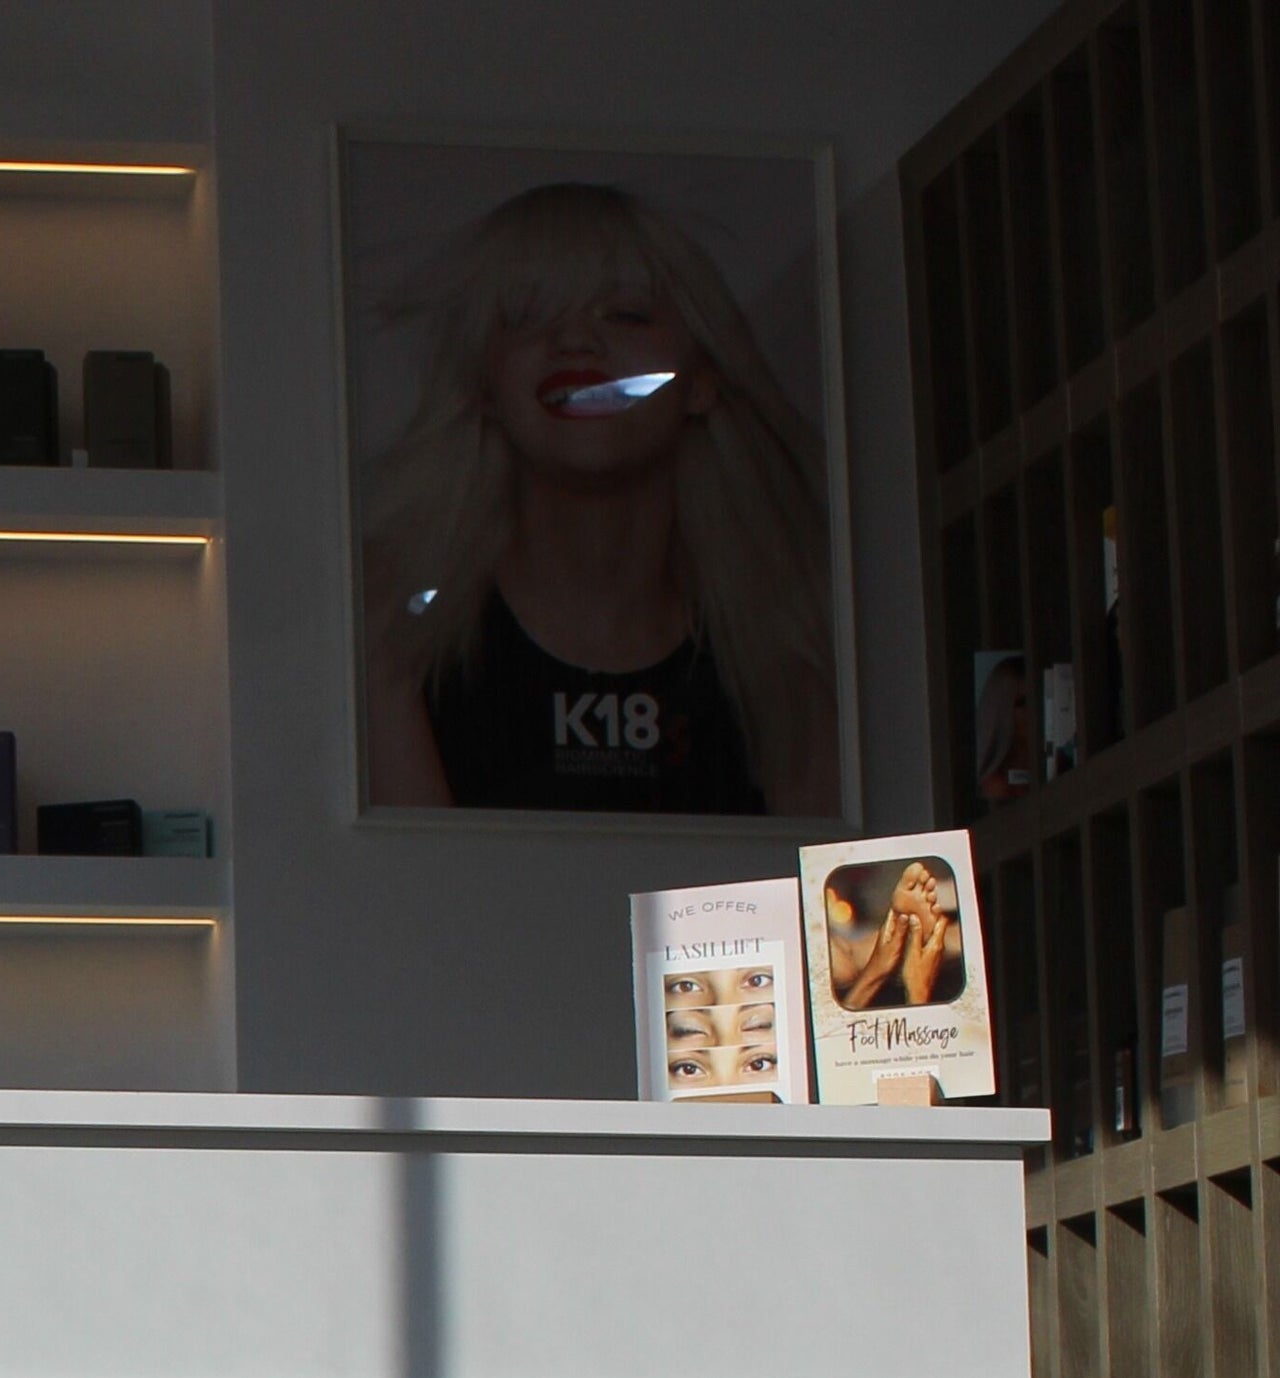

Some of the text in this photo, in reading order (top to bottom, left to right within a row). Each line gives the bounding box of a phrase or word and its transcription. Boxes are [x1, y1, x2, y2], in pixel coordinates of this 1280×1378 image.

[553, 692, 660, 750] K18
[668, 900, 757, 921] WE OFFER
[665, 937, 764, 960] LASH LIFT
[846, 1017, 959, 1052] Foot Massage
